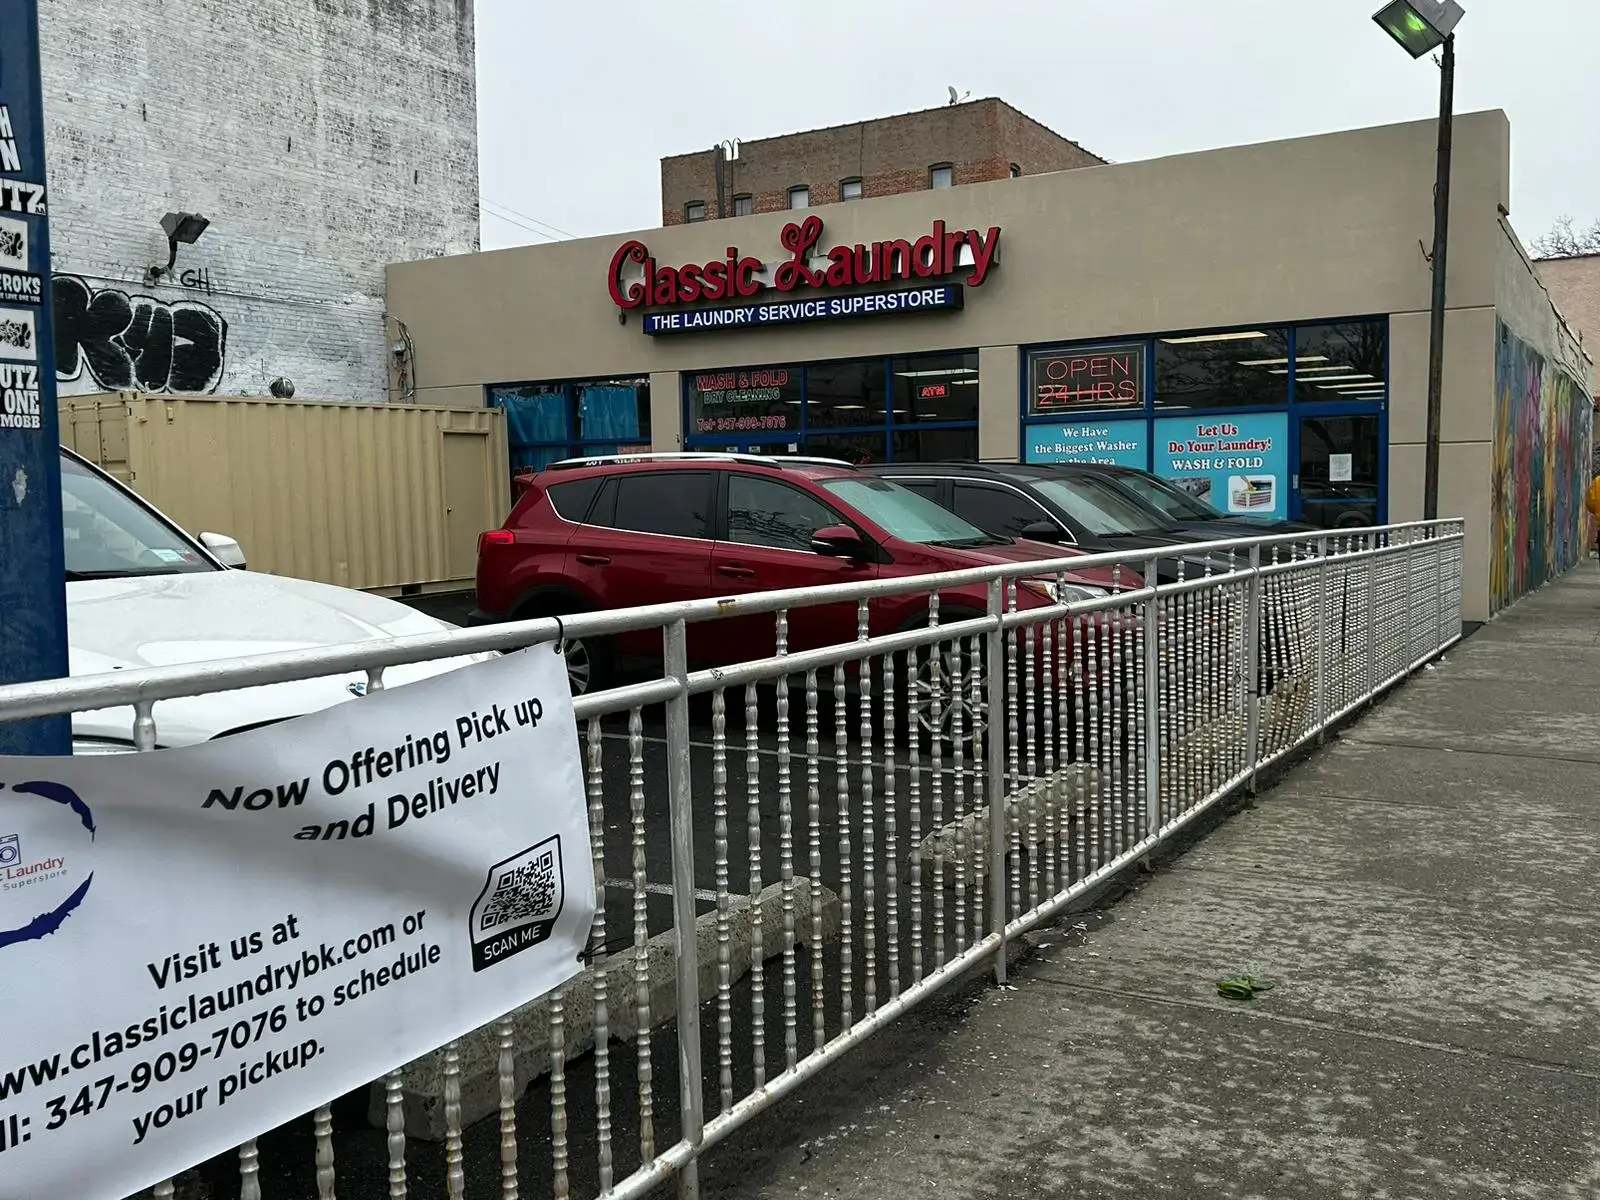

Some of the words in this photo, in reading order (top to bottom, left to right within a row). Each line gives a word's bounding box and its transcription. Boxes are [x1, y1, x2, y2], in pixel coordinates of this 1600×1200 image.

[0, 178, 46, 216] TZ
[608, 240, 765, 309] Classic
[774, 215, 1001, 292] Laundry
[0, 273, 41, 295] ROKS
[652, 315, 680, 331] THE
[684, 307, 755, 327] LAUNDRY
[759, 301, 827, 322] SERVICE
[831, 288, 946, 316] SUPERSTORE
[0, 363, 38, 390] UTZ
[696, 372, 736, 391] WASH
[739, 372, 748, 388] &
[752, 369, 788, 387] FOLD
[1046, 356, 1130, 380] OPEN
[4, 388, 40, 414] ONE
[703, 390, 725, 404] DRY
[726, 387, 780, 402] CLEANING
[921, 385, 946, 398] ATM
[1039, 384, 1069, 404] 24
[1077, 380, 1136, 401] HRS
[0, 414, 40, 429] MOBB
[1062, 428, 1080, 438] We
[1082, 427, 1108, 437] Have
[1198, 424, 1218, 437] Let
[1221, 423, 1238, 436] Us
[1035, 444, 1053, 454] the
[1055, 443, 1094, 454] Biggest
[1096, 440, 1138, 451] Washer
[1168, 441, 1184, 453] Do
[1187, 440, 1215, 452] Your
[1218, 438, 1272, 452] Laundry!
[1171, 458, 1211, 471] WASH
[1214, 458, 1225, 470] &
[1227, 457, 1264, 469] FOLD
[200, 777, 310, 811] Now
[323, 730, 451, 796] Offering
[456, 704, 511, 749] Pick
[514, 697, 544, 727] up
[293, 802, 375, 841] and
[387, 761, 501, 830] Delivery
[3, 868, 68, 891] Superstore
[7, 857, 65, 880] Laundry
[402, 909, 427, 936] or
[147, 941, 222, 990] Visit
[230, 930, 263, 961] us
[272, 913, 300, 945] at
[484, 935, 518, 961] SCAN
[521, 924, 542, 944] ME
[45, 1005, 287, 1130] 347-909-7076
[296, 994, 325, 1022] to
[333, 943, 442, 1006] schedule
[132, 1084, 208, 1144] your
[218, 1036, 326, 1106] pickup.
